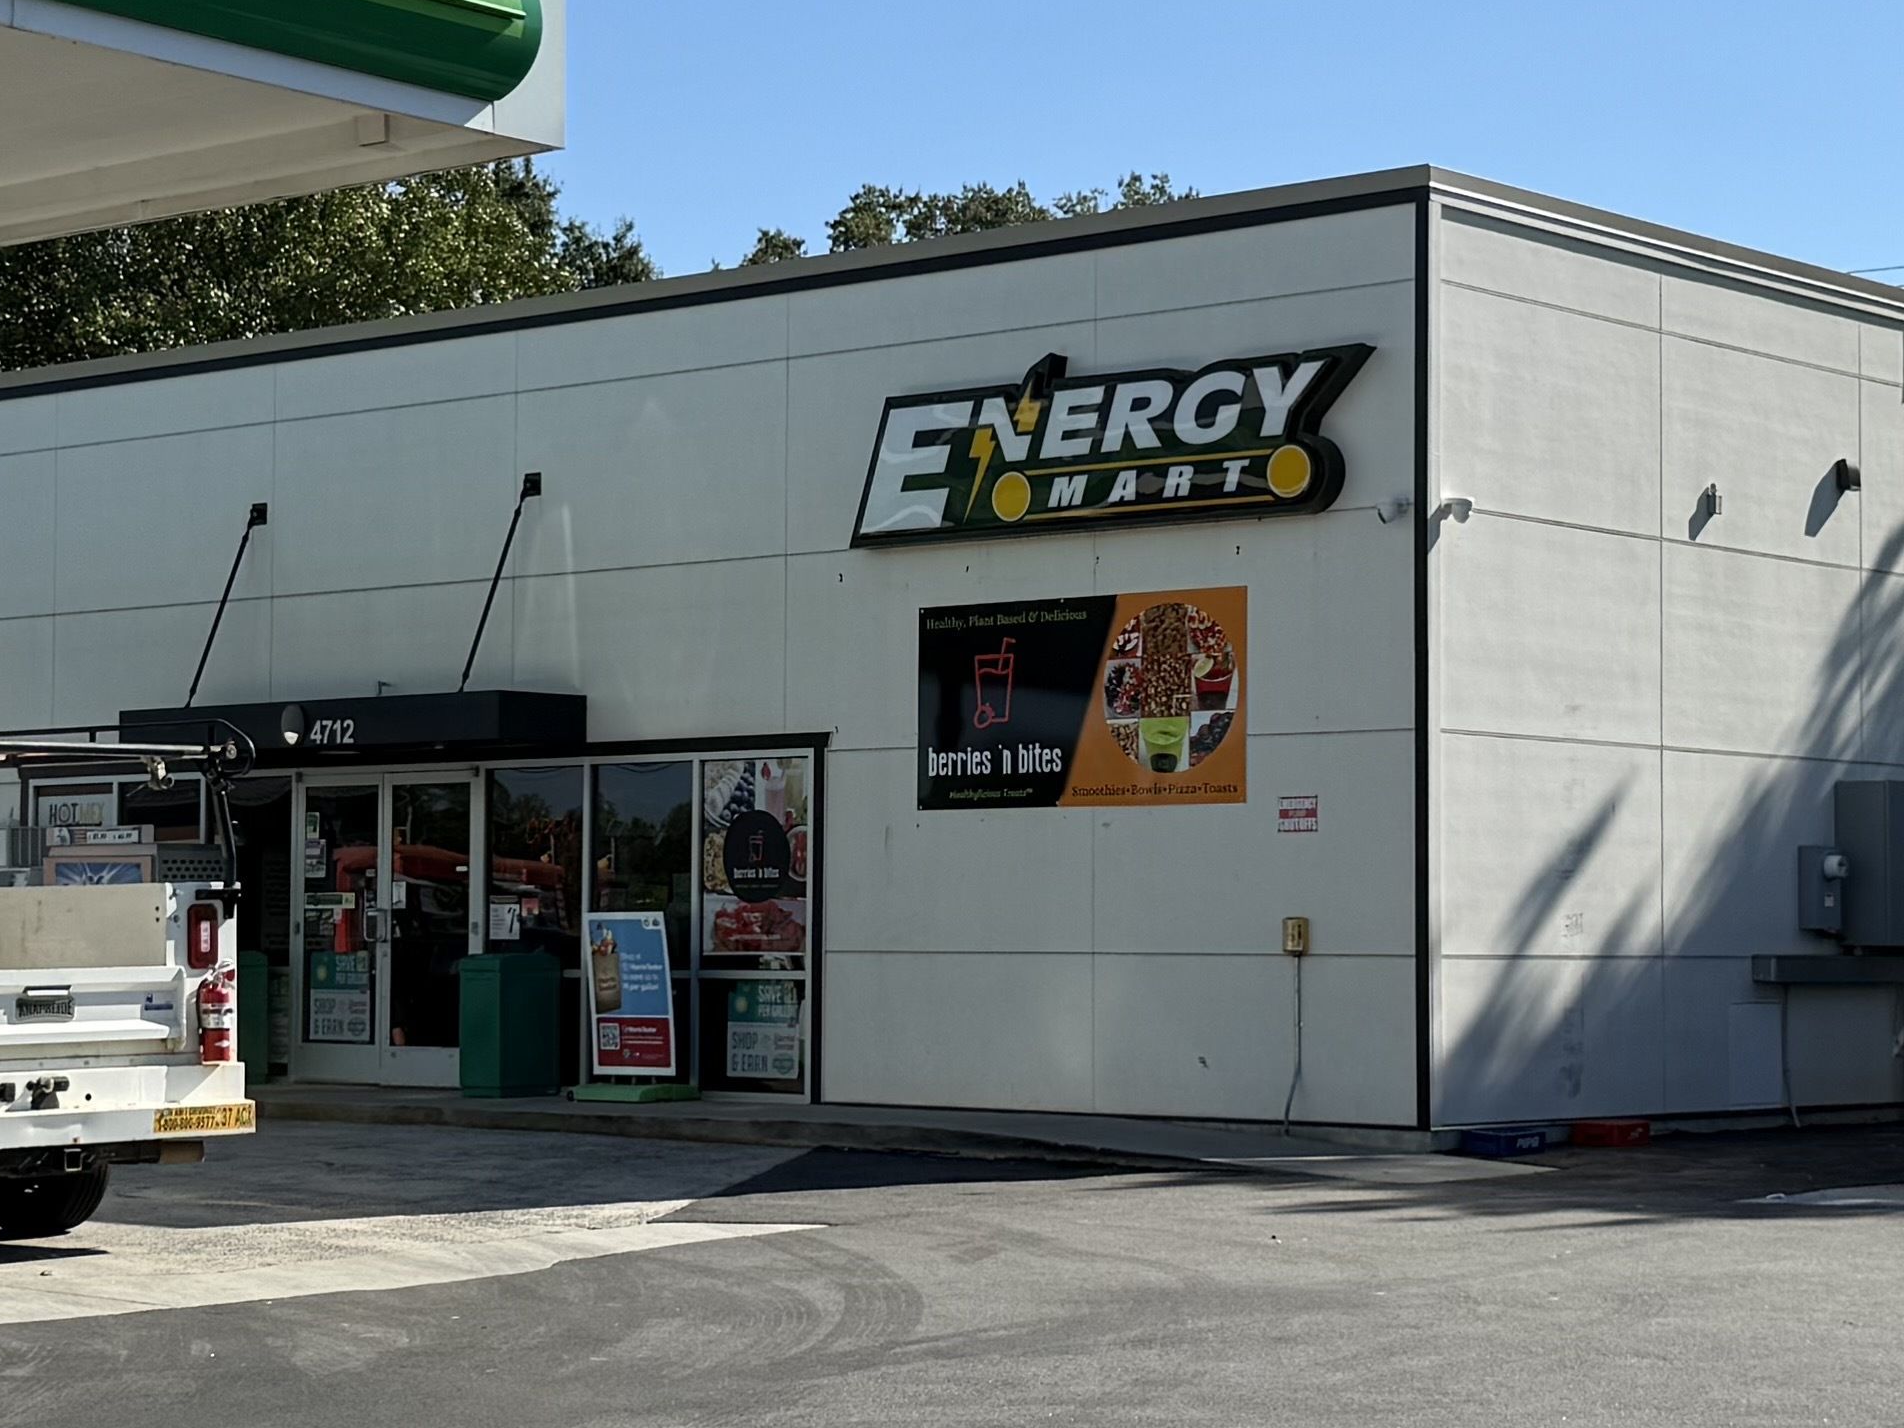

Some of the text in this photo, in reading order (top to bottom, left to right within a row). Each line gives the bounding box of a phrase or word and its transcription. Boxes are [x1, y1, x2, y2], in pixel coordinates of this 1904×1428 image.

[860, 358, 1331, 534] ENERGY
[1047, 458, 1251, 508] MART
[997, 611, 1026, 625] Based
[1028, 610, 1038, 622] &
[1040, 608, 1088, 622] Delicious
[309, 718, 355, 744] 4712
[927, 746, 992, 777] berries
[1018, 742, 1063, 774] bites
[48, 802, 79, 826] HOT
[732, 1031, 758, 1050] SHOP
[741, 1053, 768, 1073] EARN
